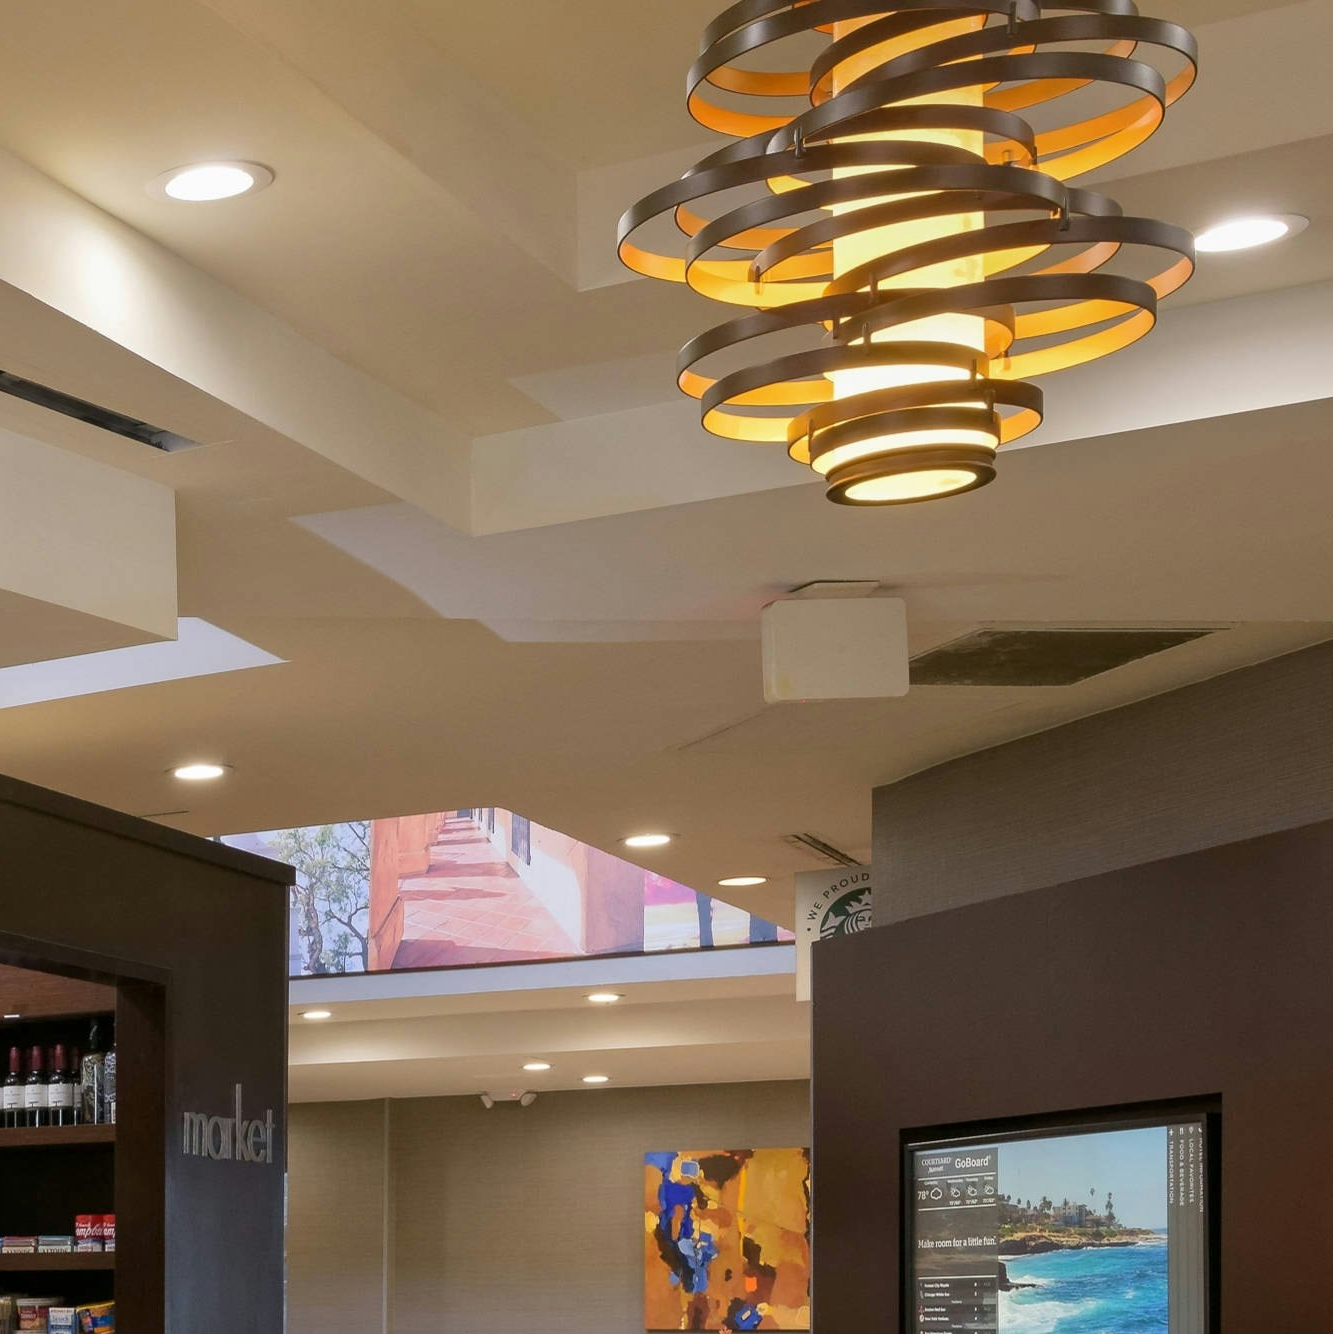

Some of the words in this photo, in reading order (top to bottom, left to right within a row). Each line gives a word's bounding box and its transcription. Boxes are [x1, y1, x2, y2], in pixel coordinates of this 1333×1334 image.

[807, 902, 823, 921] WE
[183, 1083, 275, 1164] market
[918, 1239, 934, 1248] Make
[935, 1240, 952, 1248] room
[953, 1238, 962, 1247] for
